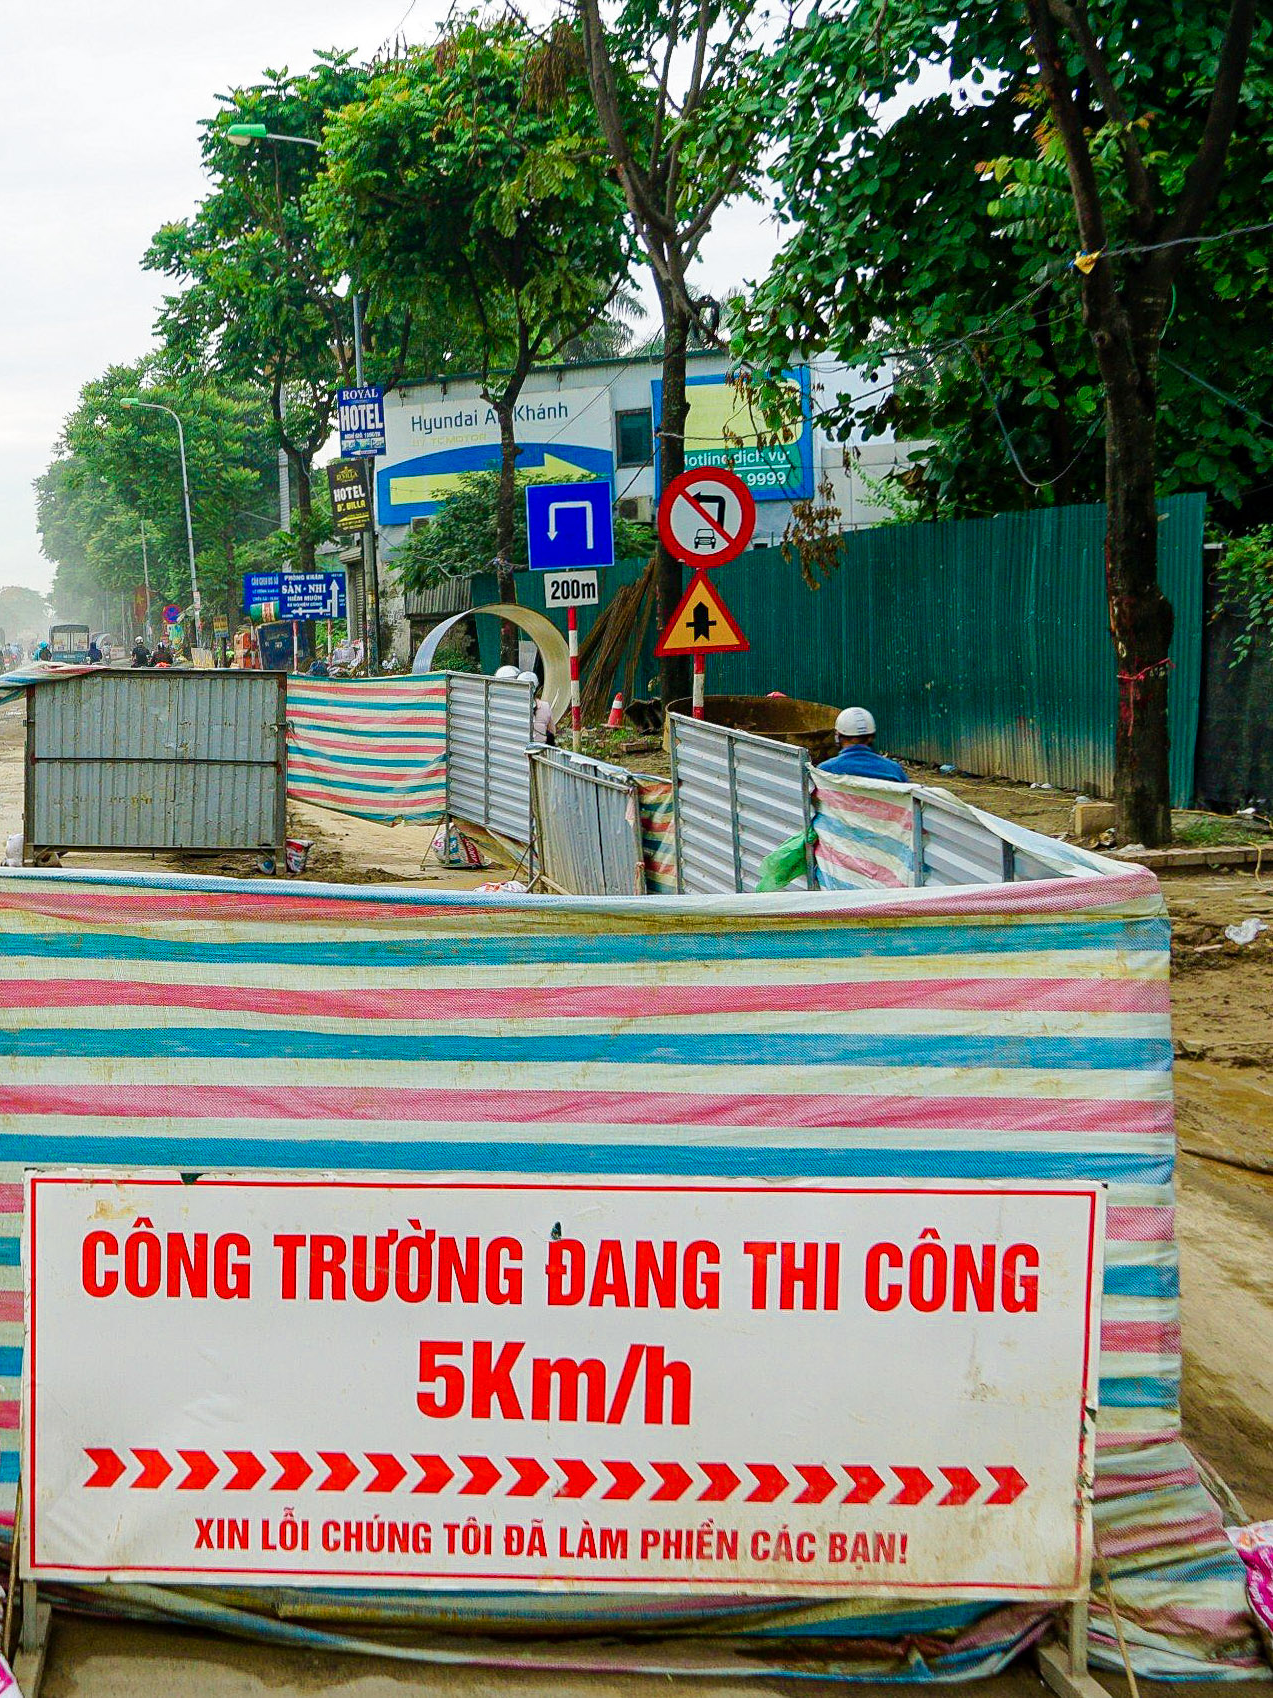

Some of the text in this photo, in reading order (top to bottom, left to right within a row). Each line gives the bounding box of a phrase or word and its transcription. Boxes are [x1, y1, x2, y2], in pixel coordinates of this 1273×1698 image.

[342, 388, 379, 400] ROYAL
[339, 402, 384, 431] HOTEL
[411, 409, 478, 435] Hyundai
[513, 401, 569, 422] Khánh
[747, 471, 787, 486] 9999
[333, 484, 366, 502] HOTEL
[308, 583, 326, 594] NHI
[551, 579, 596, 600] 200m
[82, 1216, 1040, 1314] CÔNG TRƯỜNG ĐANG THI CÔNG
[416, 1340, 692, 1426] 5Km/h
[194, 1506, 909, 1571] XIN LỖI CHÚNG TÔI ĐÃ LÀM PHIỀN CÁC BẠN!
